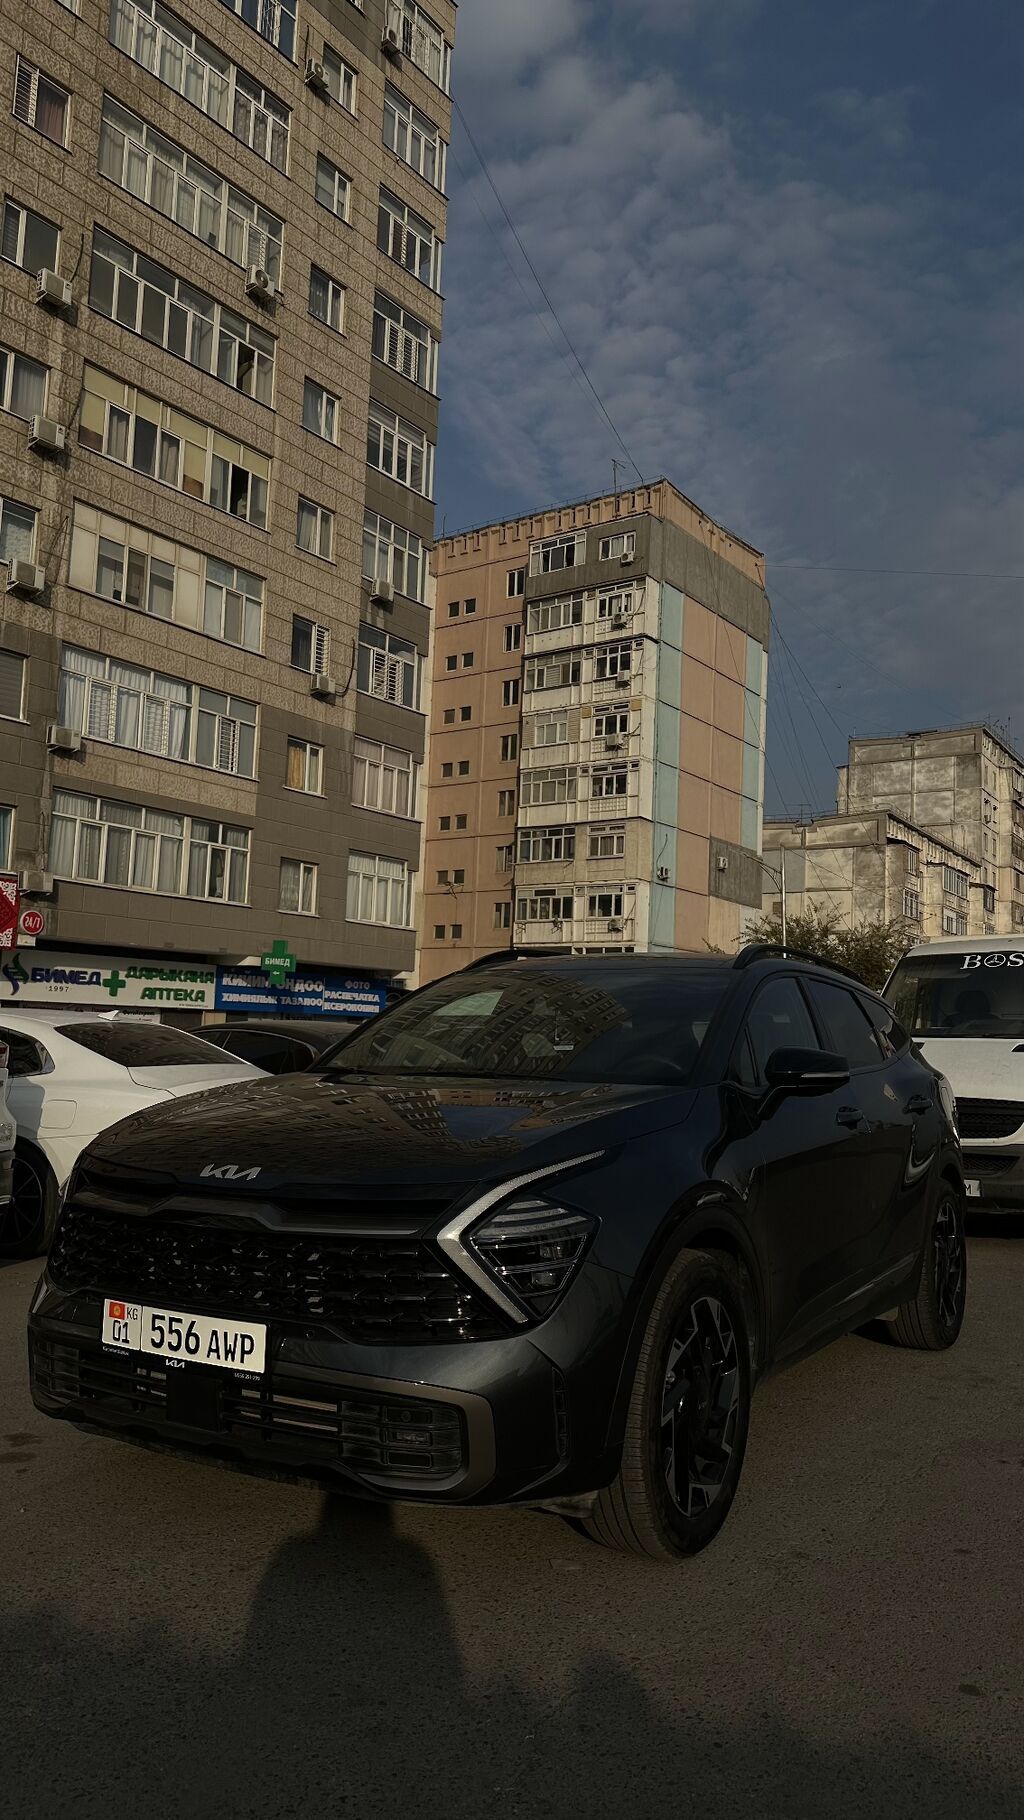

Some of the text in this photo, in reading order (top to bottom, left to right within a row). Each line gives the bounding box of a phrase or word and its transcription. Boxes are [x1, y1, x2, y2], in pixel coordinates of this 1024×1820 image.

[24, 916, 41, 929] 24/7
[265, 957, 291, 968] БИМЕД
[31, 967, 101, 986] БИМЕД
[125, 966, 215, 984] ДАРЫКАНА
[48, 985, 69, 993] 1997
[345, 980, 371, 990] ФОТО
[140, 987, 206, 1003] АПТЕКА
[280, 996, 323, 1006] ТАЗАЛОО
[324, 990, 380, 1002] РАСПЕЧАТКА
[199, 1163, 262, 1181] KIA
[126, 1307, 138, 1321] KG
[112, 1320, 130, 1344] 01
[150, 1313, 255, 1364] 556 AWP
[165, 1359, 185, 1369] KIA
